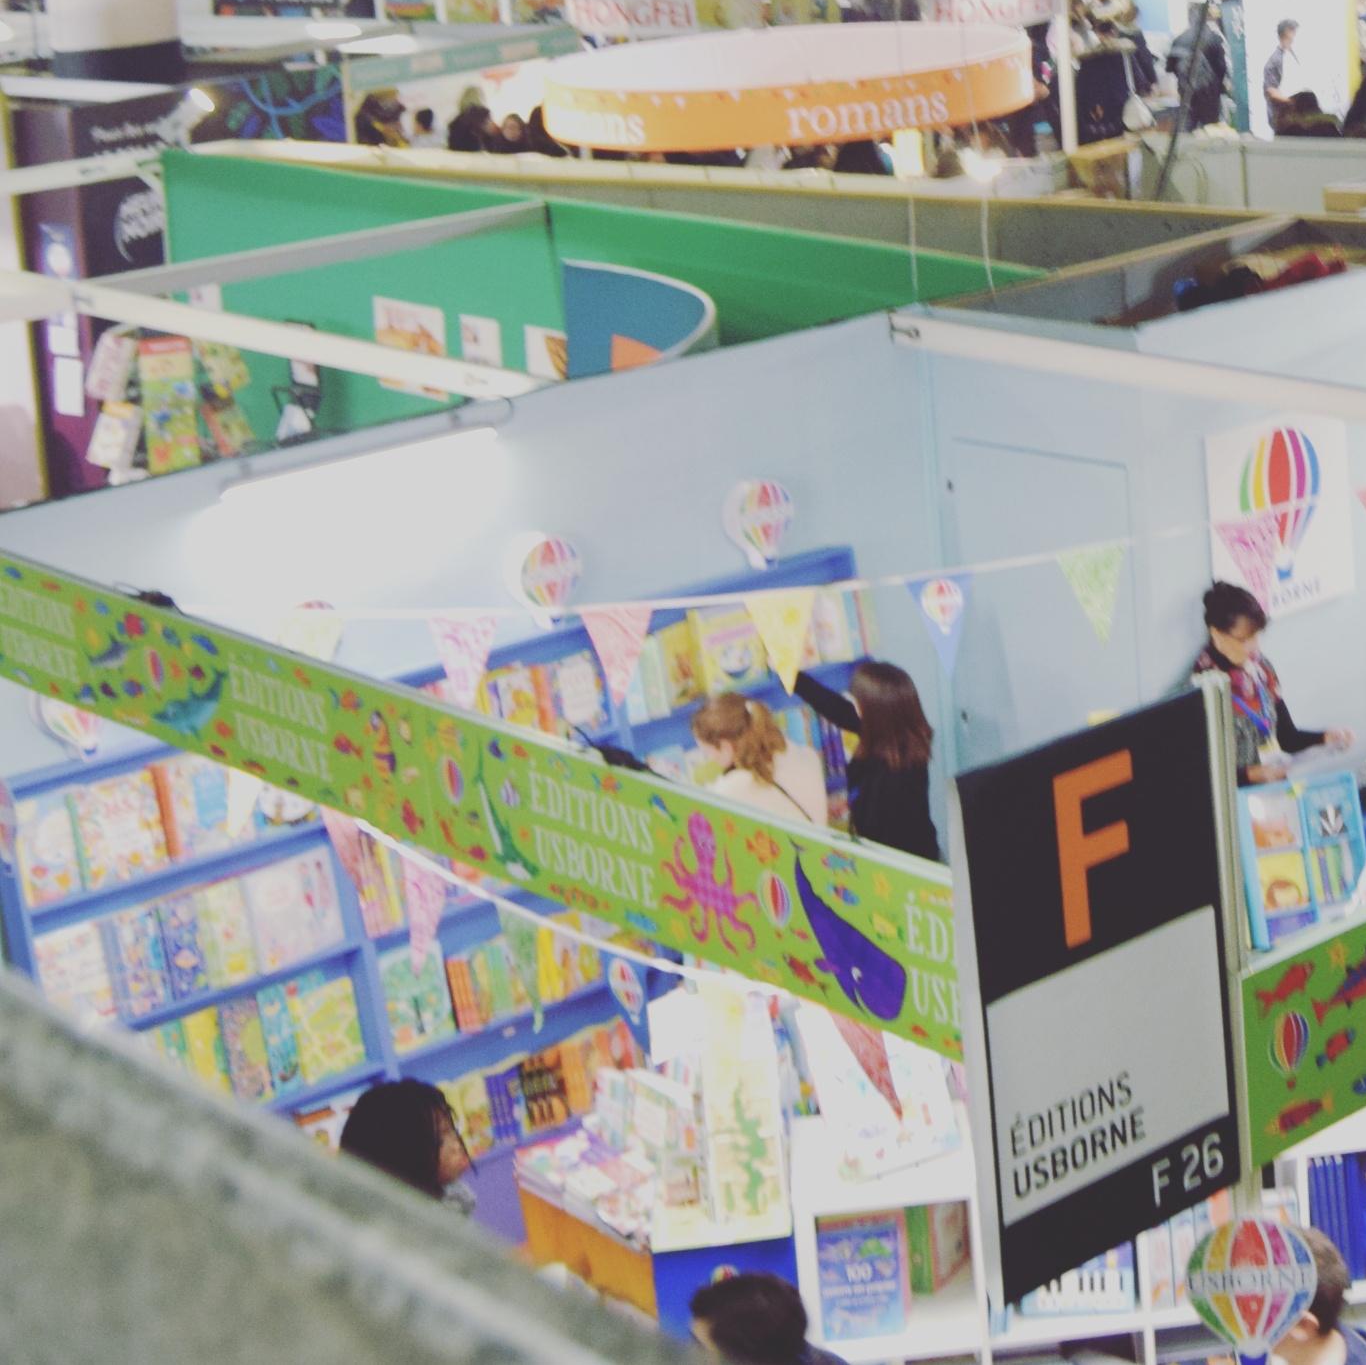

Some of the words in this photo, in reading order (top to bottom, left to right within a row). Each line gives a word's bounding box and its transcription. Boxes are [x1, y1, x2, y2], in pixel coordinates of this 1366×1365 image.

[786, 90, 950, 139] romans
[529, 757, 655, 856] ÉDITIONS
[1053, 748, 1133, 950] F
[533, 824, 658, 910] USBORNE
[1010, 1070, 1133, 1159] ÉDITIONS
[1012, 1105, 1146, 1200] USBORNE
[1151, 1156, 1171, 1208] F
[1180, 1131, 1224, 1193] 26
